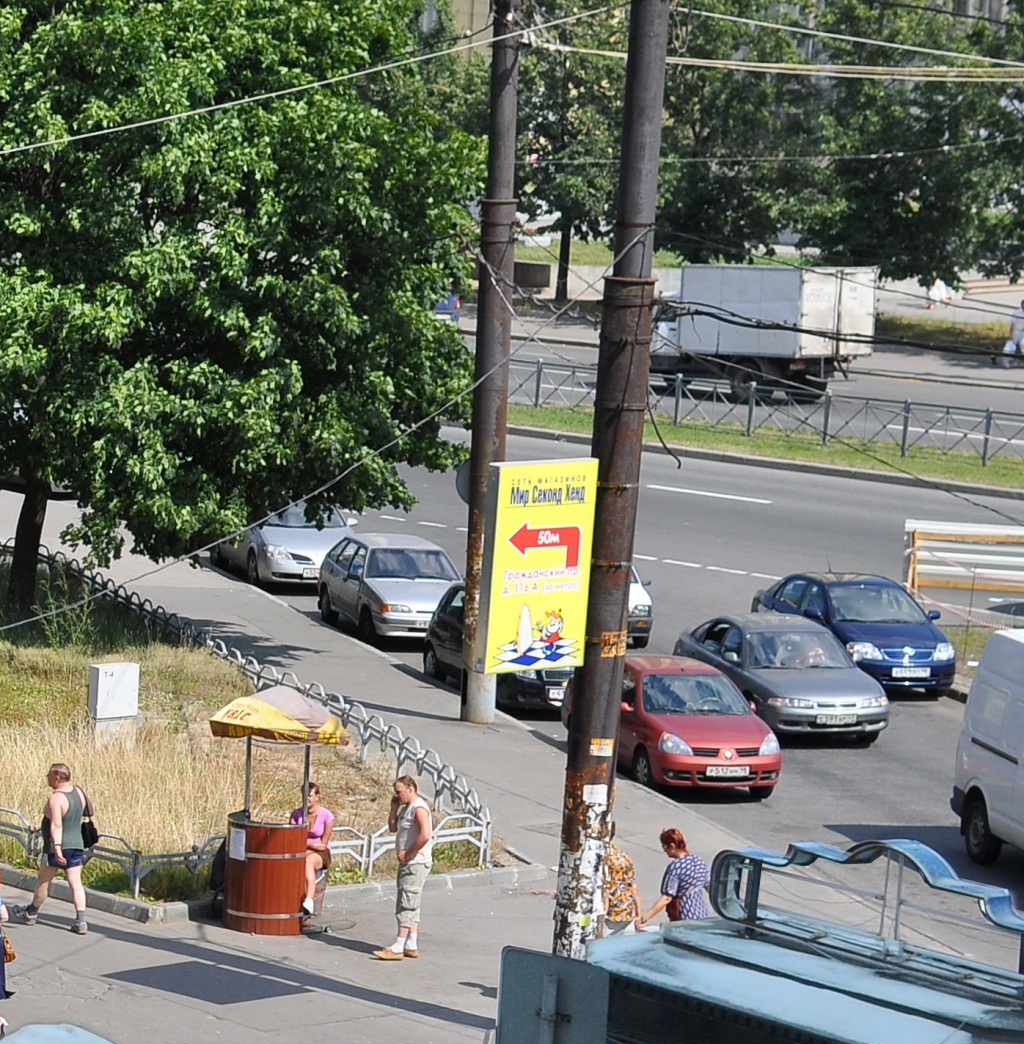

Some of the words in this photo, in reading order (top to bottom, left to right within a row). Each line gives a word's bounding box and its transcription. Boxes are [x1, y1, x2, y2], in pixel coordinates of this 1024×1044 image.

[537, 475, 587, 484] МАГАЗИНОВ
[510, 486, 529, 507] Мир
[532, 485, 563, 505] Секонд
[565, 484, 585, 503] Хенд
[504, 567, 565, 581] Гражданский
